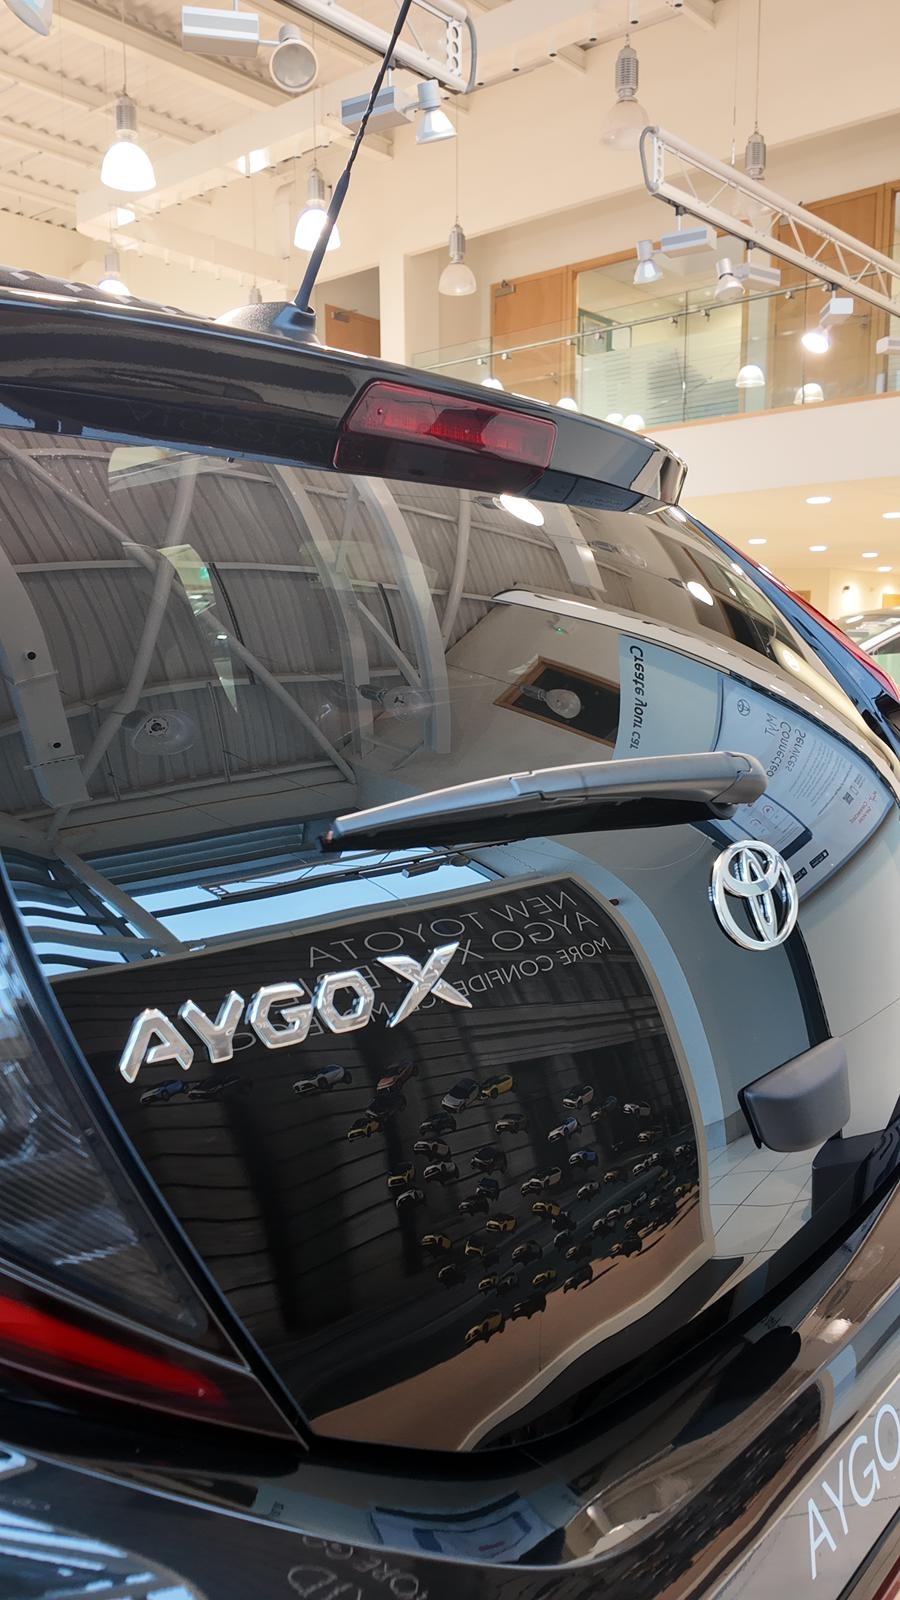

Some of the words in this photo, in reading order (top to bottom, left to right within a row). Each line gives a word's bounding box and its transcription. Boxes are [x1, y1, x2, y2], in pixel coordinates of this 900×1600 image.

[118, 971, 376, 1084] AYGO
[375, 941, 474, 1028] X
[807, 1403, 900, 1581] AYGO
